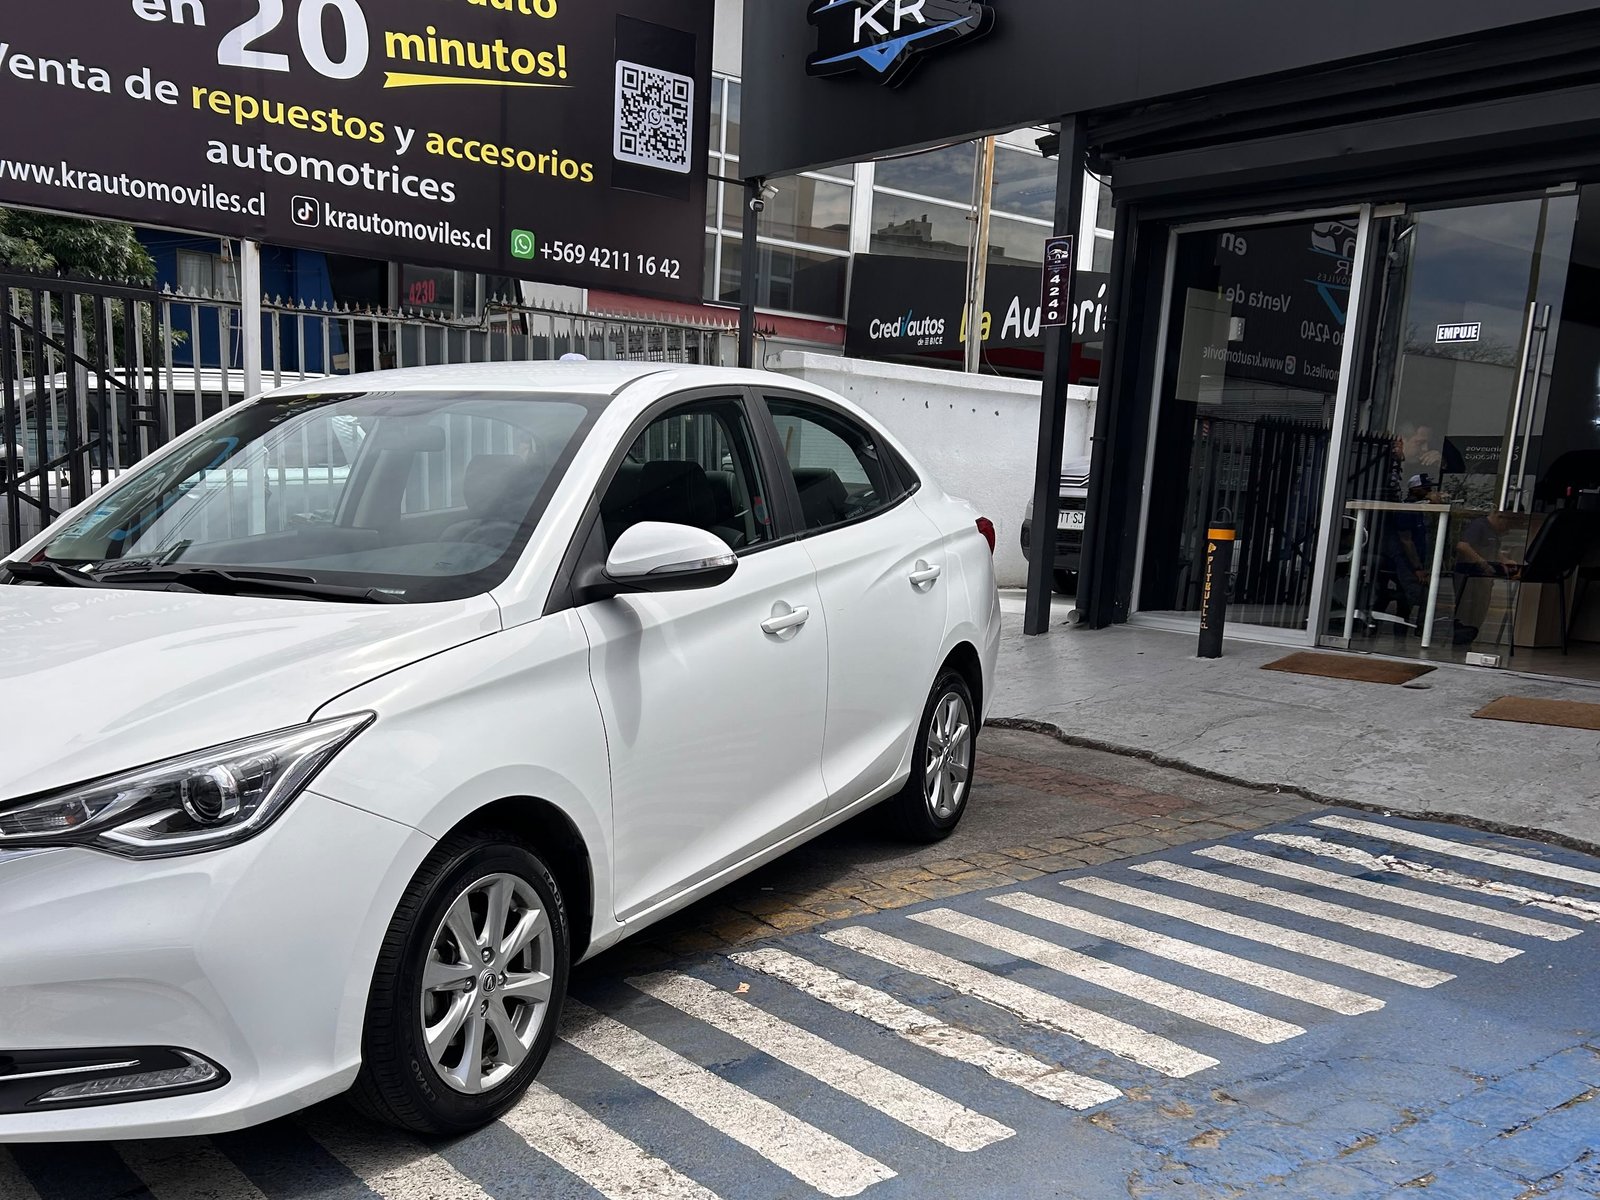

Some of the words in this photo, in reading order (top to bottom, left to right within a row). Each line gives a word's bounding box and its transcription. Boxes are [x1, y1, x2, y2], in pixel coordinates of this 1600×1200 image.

[132, 0, 206, 27] en
[217, 0, 369, 80] 20
[385, 26, 568, 79] minutos!
[853, 0, 926, 43] KR
[124, 67, 179, 105] de
[192, 86, 386, 144] repuestos
[393, 124, 415, 156] y
[426, 132, 594, 183] accesorios
[206, 140, 456, 203] automotrices
[324, 202, 491, 250] krautomoviles.cl
[540, 240, 586, 264] +569
[589, 247, 629, 272] 4211
[637, 254, 657, 276] 16
[660, 258, 680, 280] 42
[409, 279, 435, 304] 4230
[1047, 274, 1061, 320] 4240
[1438, 325, 1478, 340] EMPUJE
